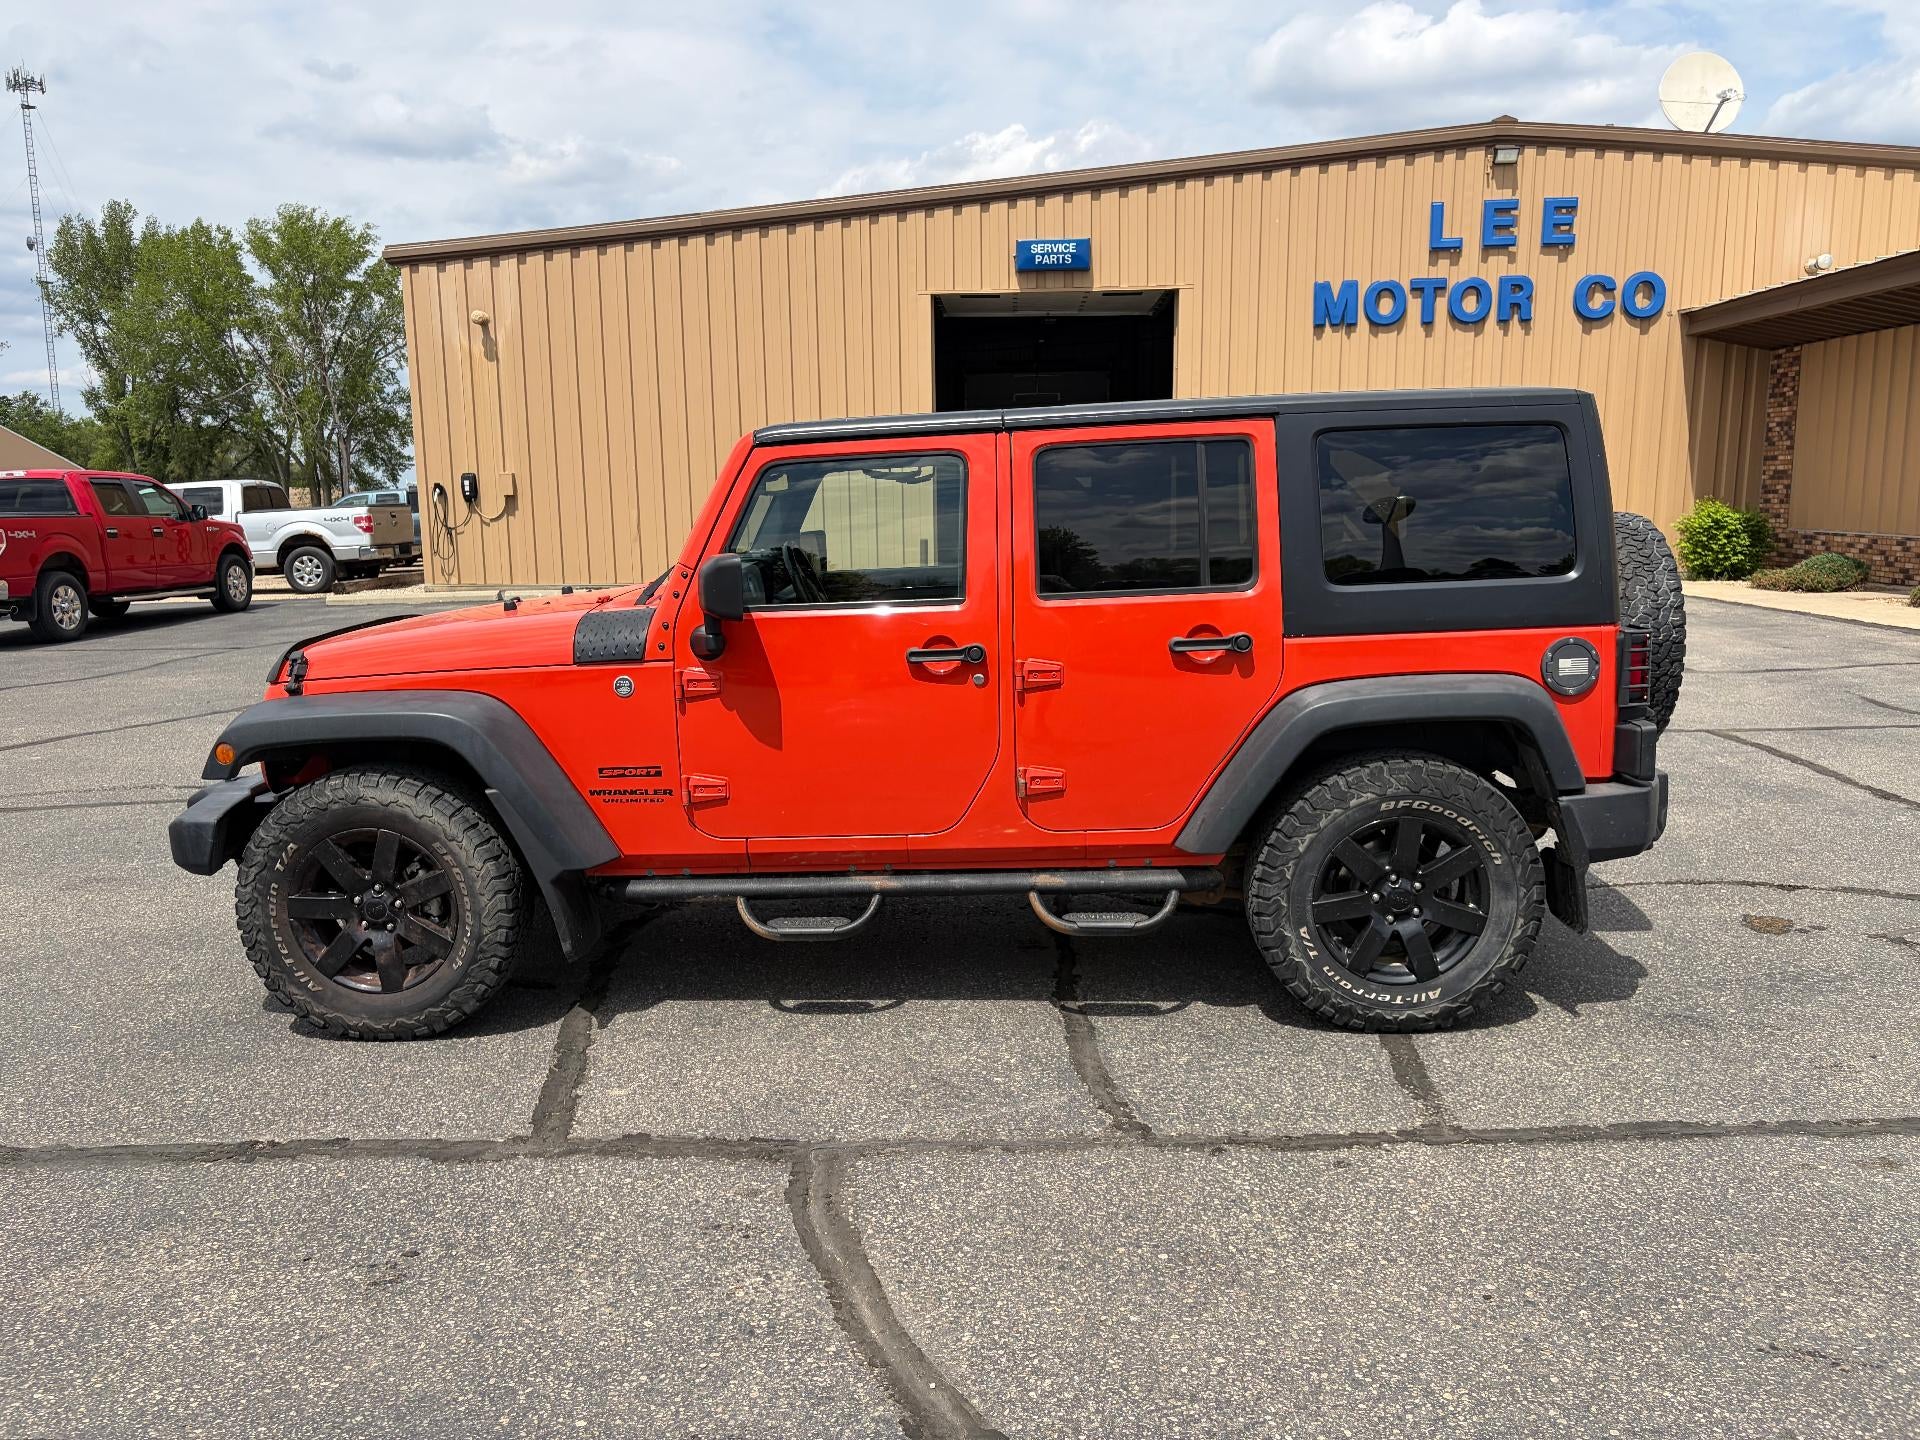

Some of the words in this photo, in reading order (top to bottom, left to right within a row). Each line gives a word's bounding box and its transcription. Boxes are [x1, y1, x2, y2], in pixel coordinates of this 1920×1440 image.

[1429, 197, 1578, 250] LEE
[1030, 242, 1077, 254] SERVICE
[1035, 254, 1072, 265] PARTS
[1313, 275, 1534, 328] MOTOR
[1573, 271, 1667, 320] CO
[602, 768, 662, 776] SPORT
[588, 788, 674, 797] WRANGLER
[1379, 799, 1503, 866] BFGoodrich
[273, 842, 300, 873] T/A
[1299, 925, 1319, 960] T/A
[1322, 964, 1442, 1005] All-Terrain
